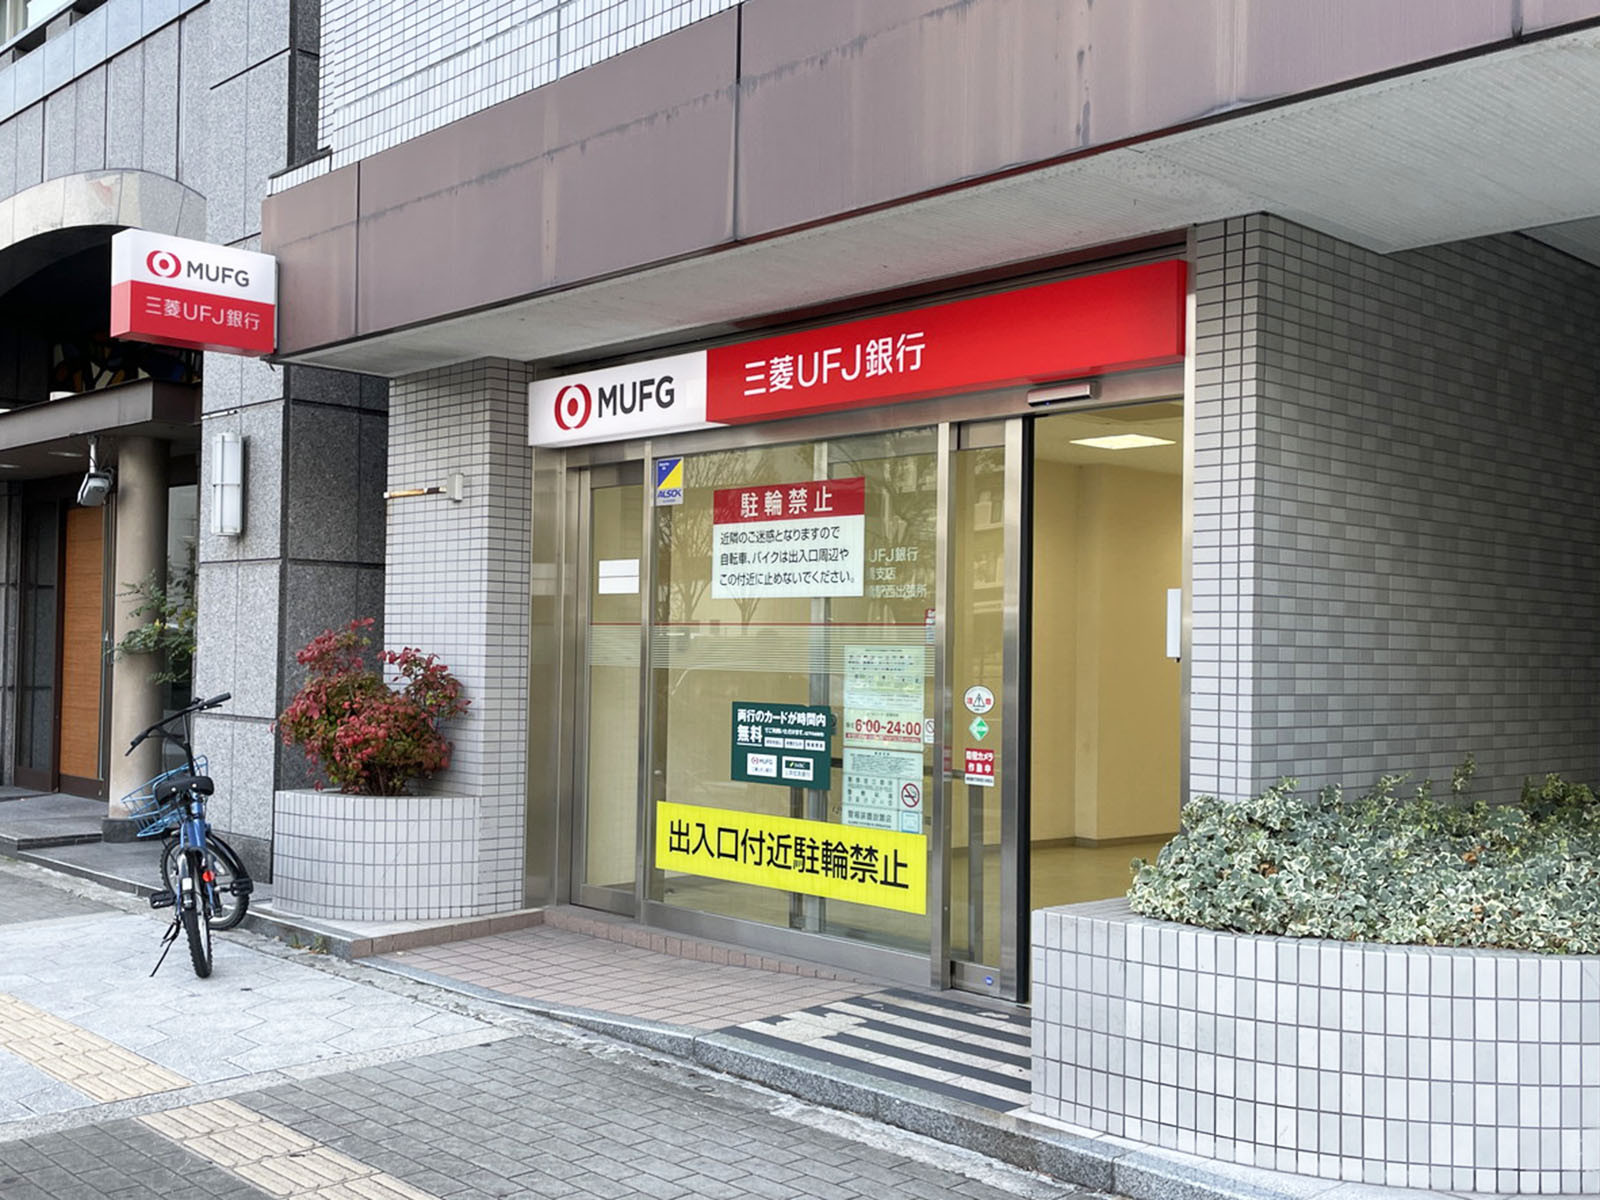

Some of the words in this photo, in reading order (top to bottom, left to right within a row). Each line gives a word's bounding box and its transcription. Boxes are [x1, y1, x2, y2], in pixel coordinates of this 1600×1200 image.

[187, 260, 250, 288] MUFG
[145, 296, 260, 331] 三菱UFJ銀行
[743, 331, 926, 397] 三菱UFJ銀行
[598, 376, 675, 418] MUFG
[740, 485, 833, 519] 駐輪禁止
[720, 526, 840, 546] 近隣のご迷惑となりますので
[720, 570, 856, 587] この付近に止めないでください。
[737, 724, 763, 743] 無料
[668, 818, 910, 890] 出入口付近駐輪禁止
